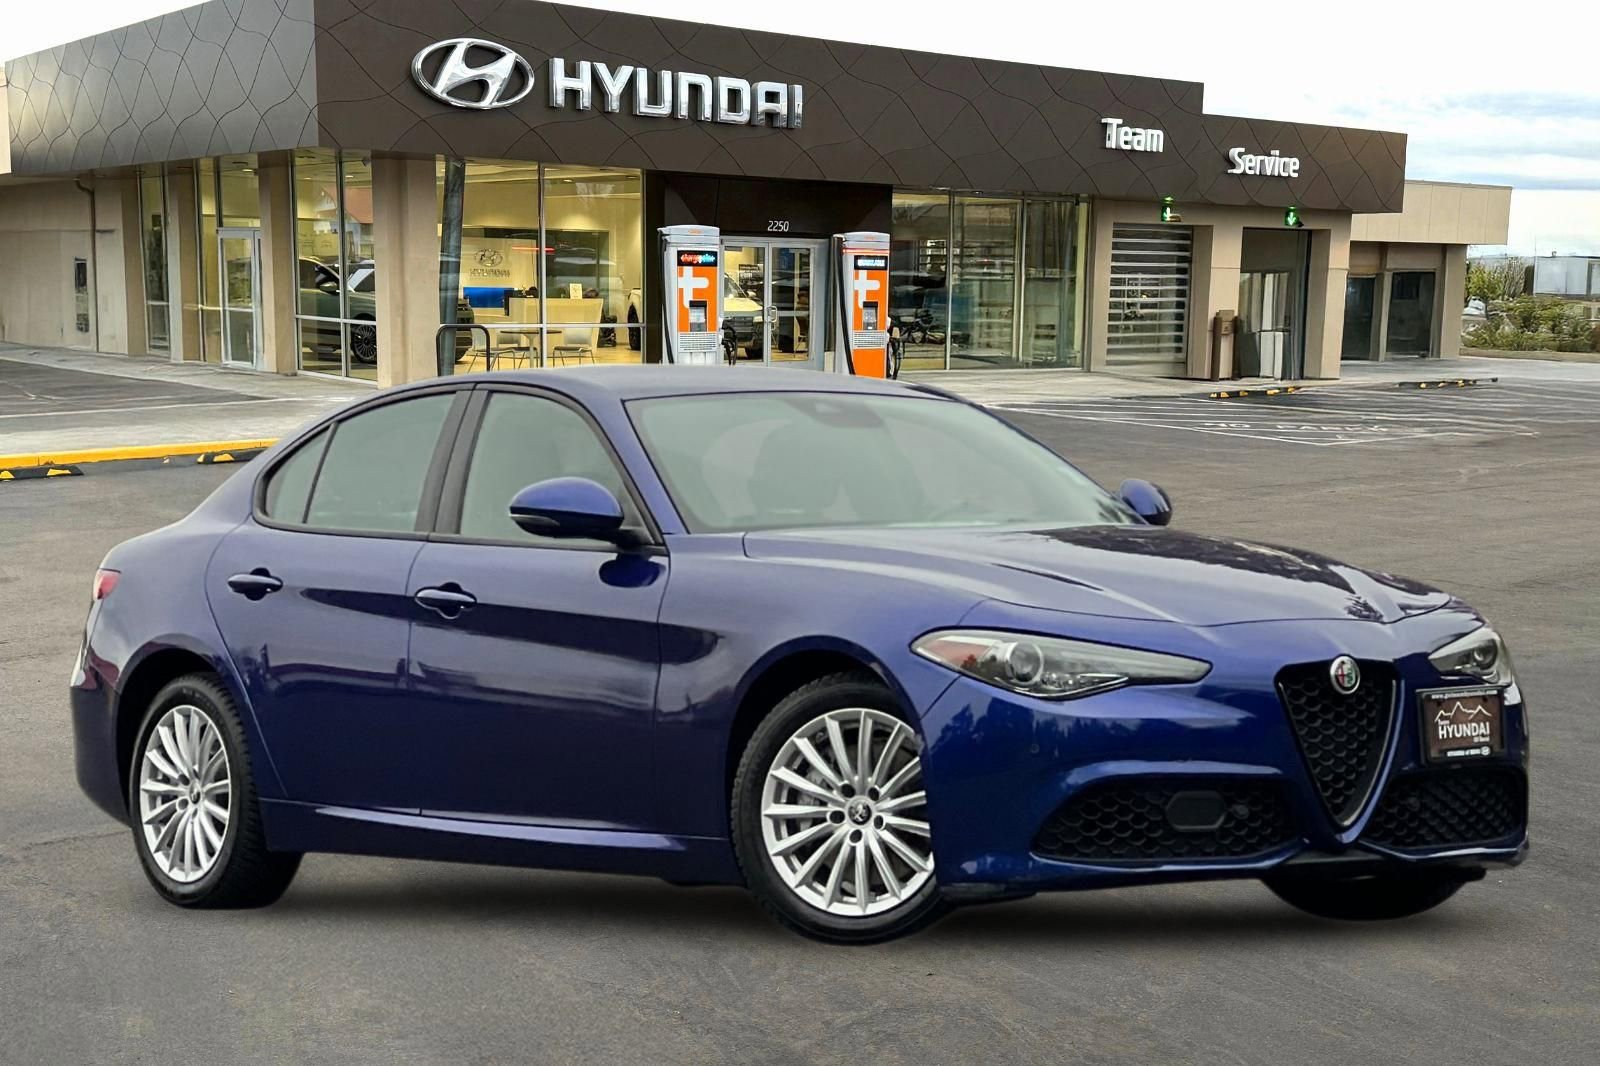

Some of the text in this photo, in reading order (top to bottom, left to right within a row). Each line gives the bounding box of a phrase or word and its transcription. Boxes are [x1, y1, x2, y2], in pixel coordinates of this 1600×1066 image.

[549, 57, 803, 128] HYUNDAI
[1101, 117, 1164, 153] Team
[1227, 147, 1300, 177] Service
[767, 220, 790, 232] 2250
[1438, 721, 1490, 740] HYUNDAI
